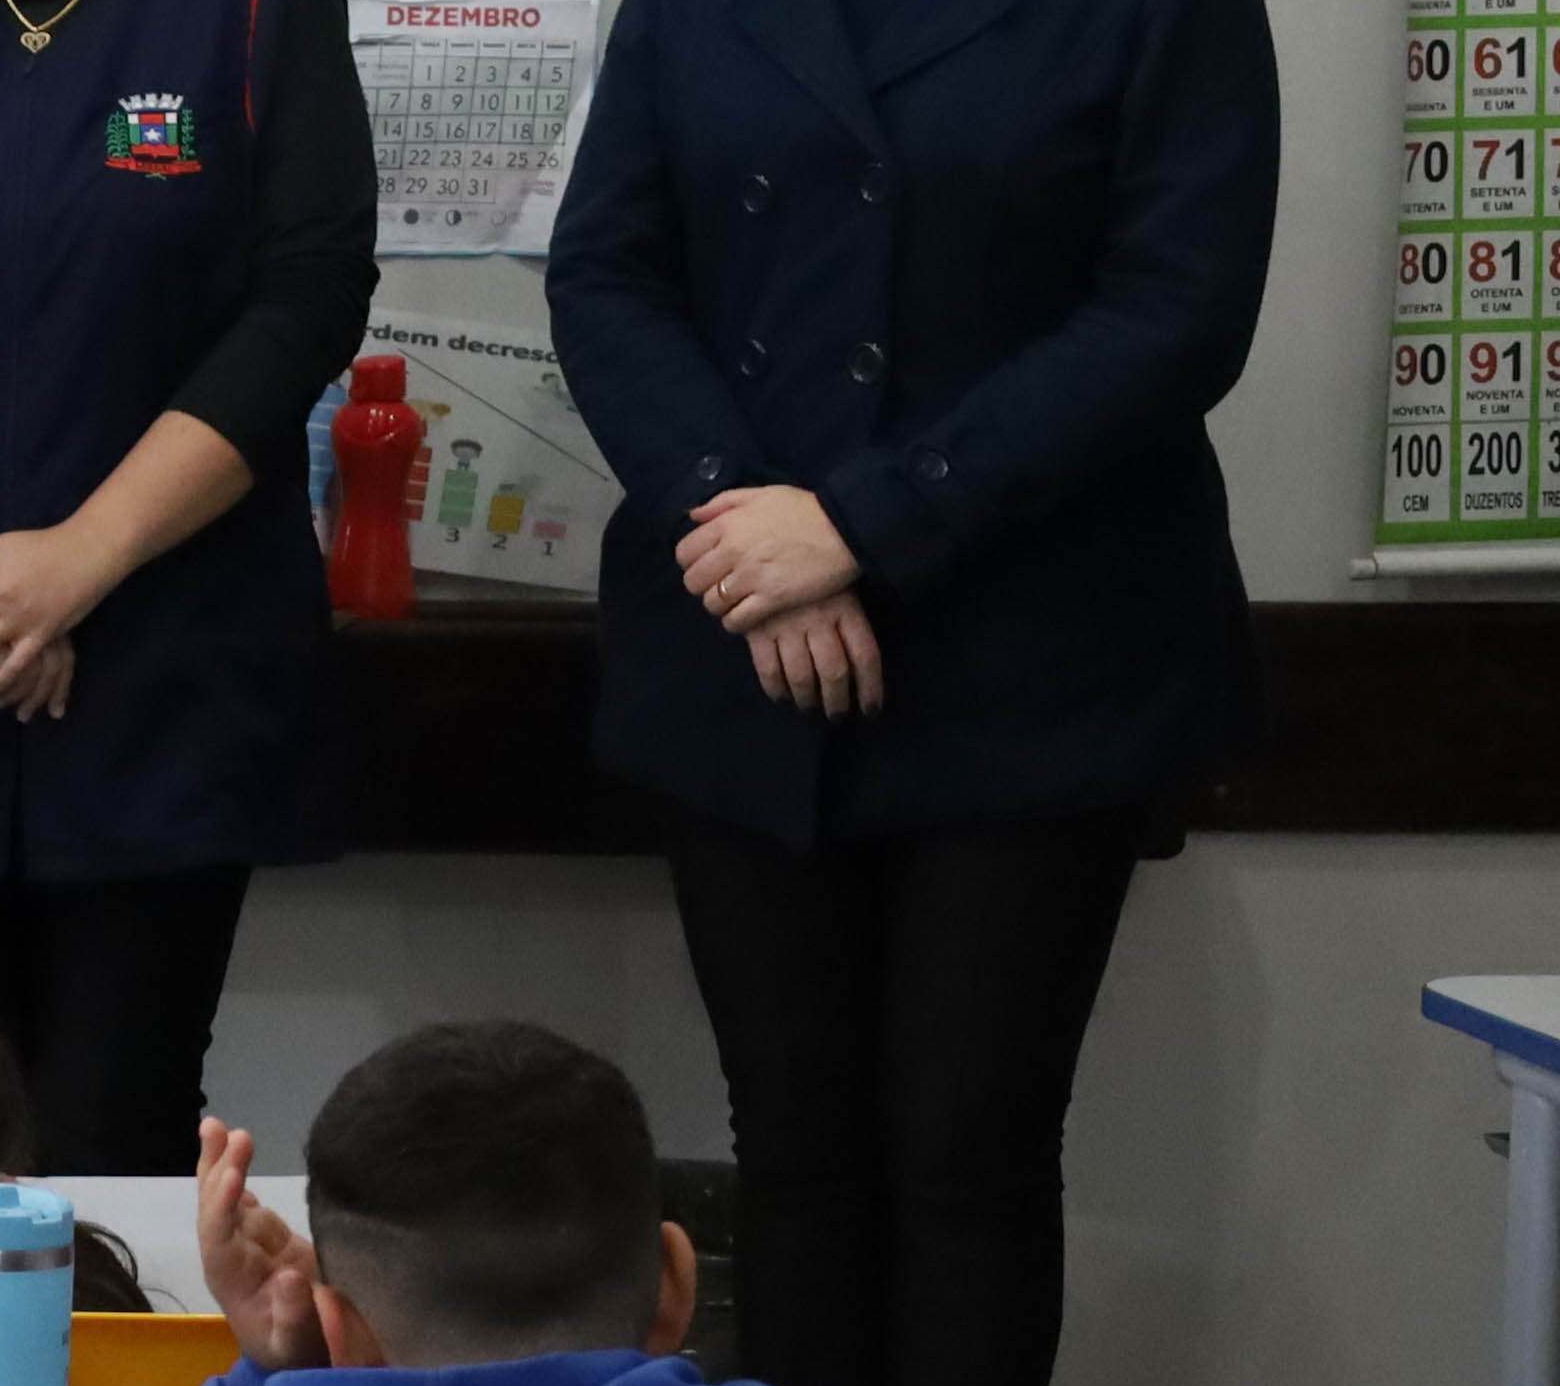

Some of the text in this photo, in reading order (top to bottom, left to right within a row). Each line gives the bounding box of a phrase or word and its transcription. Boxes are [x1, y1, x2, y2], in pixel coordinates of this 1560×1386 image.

[387, 2, 540, 28] DEZEMBRO
[1408, 39, 1450, 81] 60
[1474, 38, 1525, 79] 61
[1405, 141, 1448, 182] 70
[1473, 139, 1524, 180] 71
[1400, 243, 1446, 285] 80
[1468, 240, 1520, 282] 81
[1395, 344, 1446, 385] 90
[1470, 341, 1521, 383] 91
[1392, 434, 1442, 477] 100
[1468, 432, 1522, 475] 200
[1403, 495, 1428, 512] CEM
[1465, 493, 1523, 511] DUZENTOS
[445, 528, 553, 556] 3 2 1
